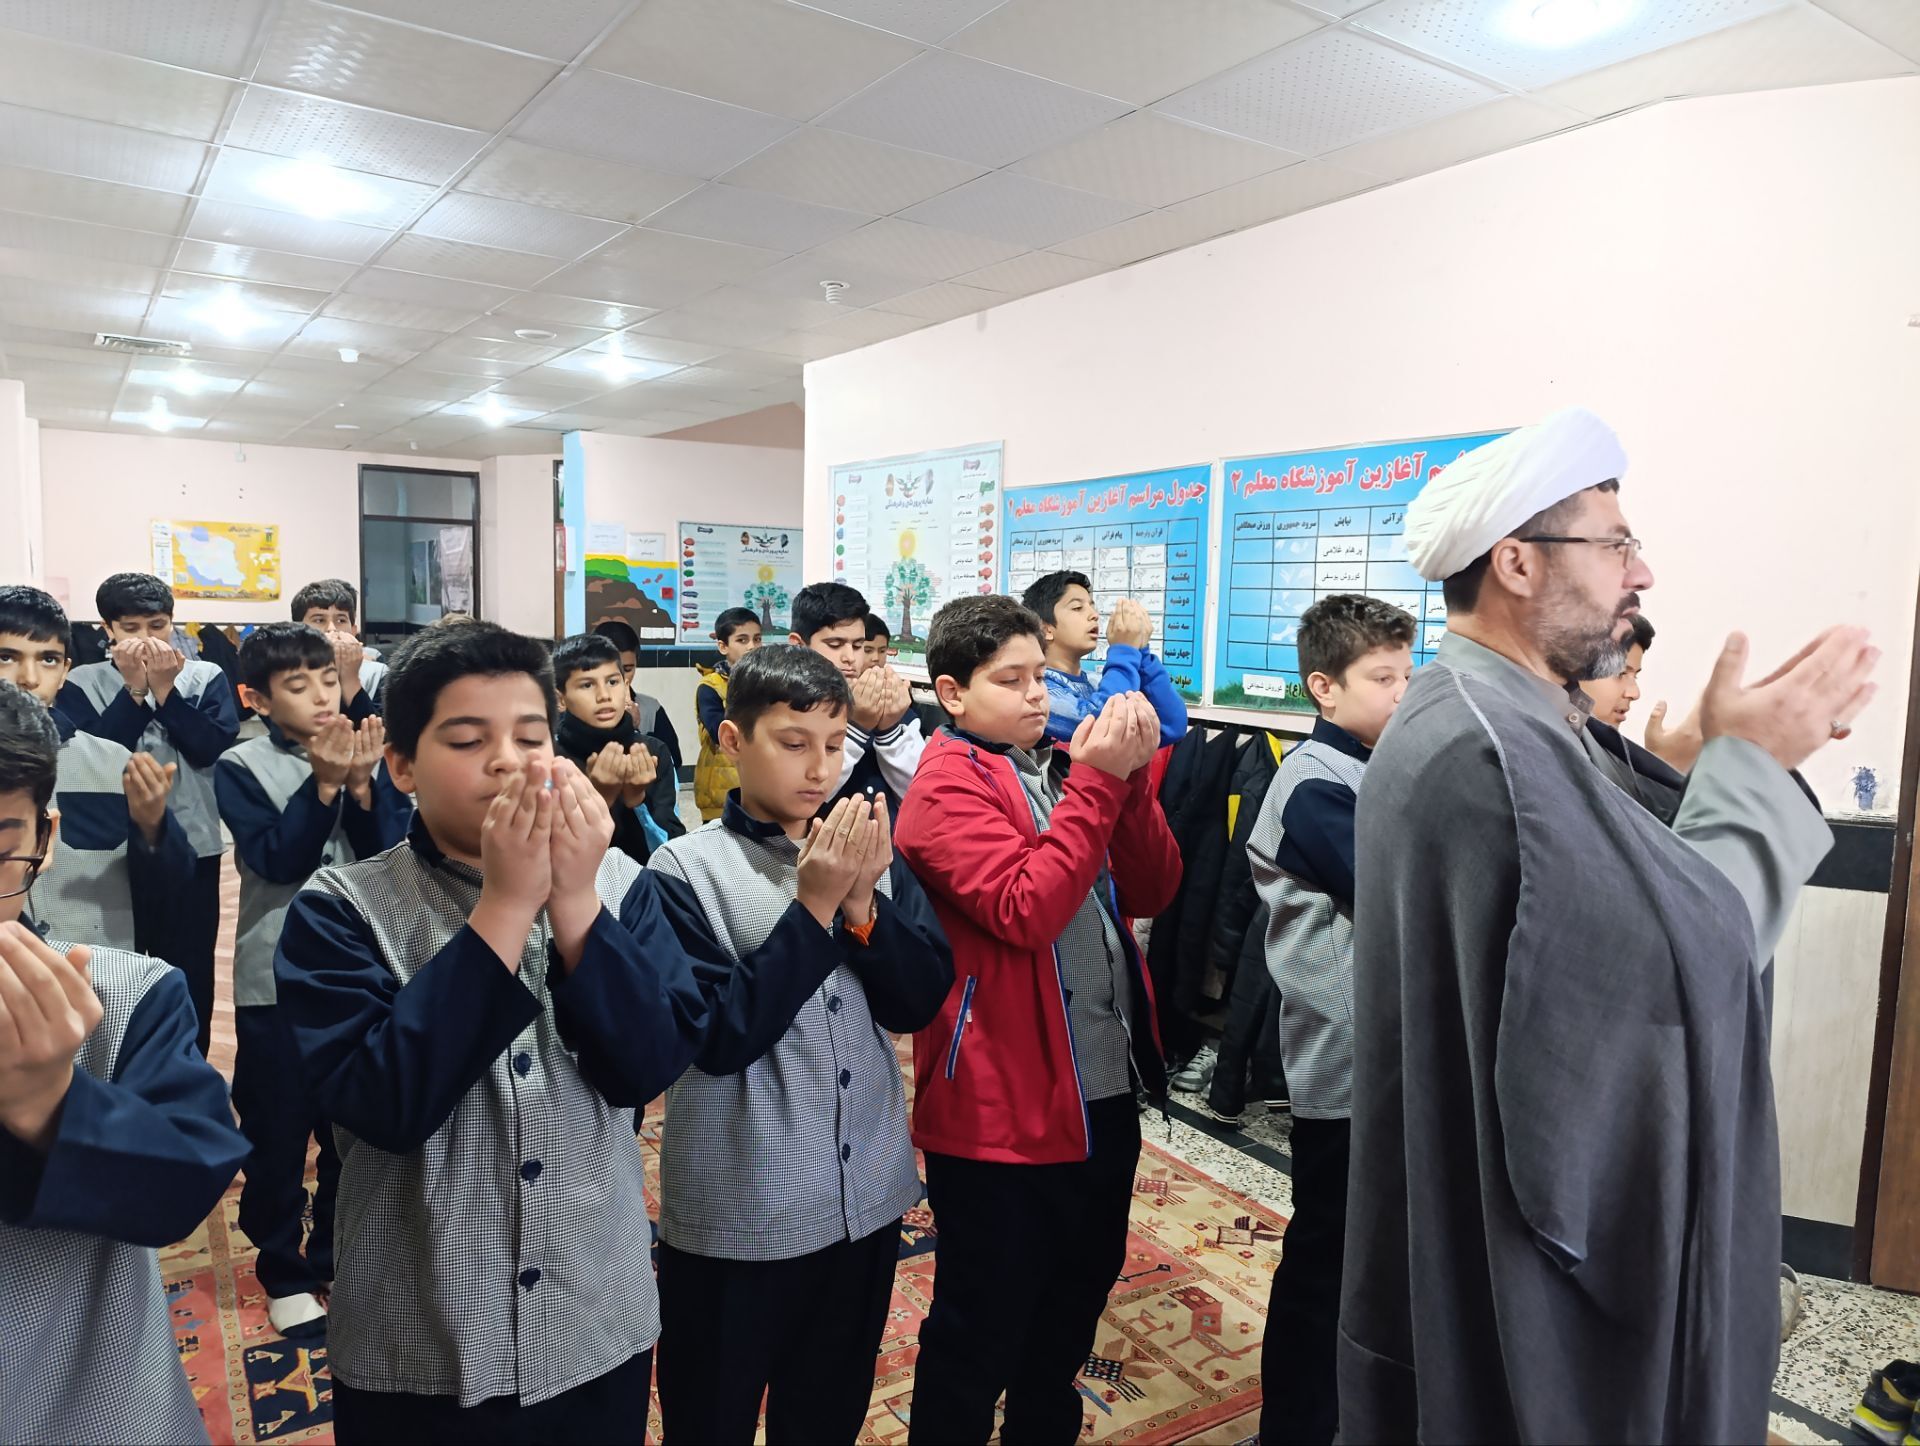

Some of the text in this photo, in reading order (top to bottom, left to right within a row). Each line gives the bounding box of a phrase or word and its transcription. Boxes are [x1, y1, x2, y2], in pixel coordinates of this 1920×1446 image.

[1281, 460, 1356, 494] آموزشگاه
[1359, 453, 1425, 489] آغازین
[1244, 472, 1276, 498] معلم
[1088, 484, 1127, 513] آغازین
[1128, 484, 1163, 508] مراسم
[1168, 481, 1206, 506] جدول
[1015, 498, 1035, 518] معلم
[1039, 490, 1085, 516] آموزشگاه
[1256, 521, 1271, 531] ورزش
[1276, 521, 1317, 531] سرود جمهوری
[1334, 515, 1351, 527] نیایش
[1151, 528, 1163, 538] قرآن
[1175, 550, 1187, 559] شنبه
[1323, 545, 1341, 557] غلامی
[1171, 572, 1190, 583] یکشنبه
[1170, 596, 1190, 606] دوشنبه
[1175, 675, 1192, 689] صلوات
